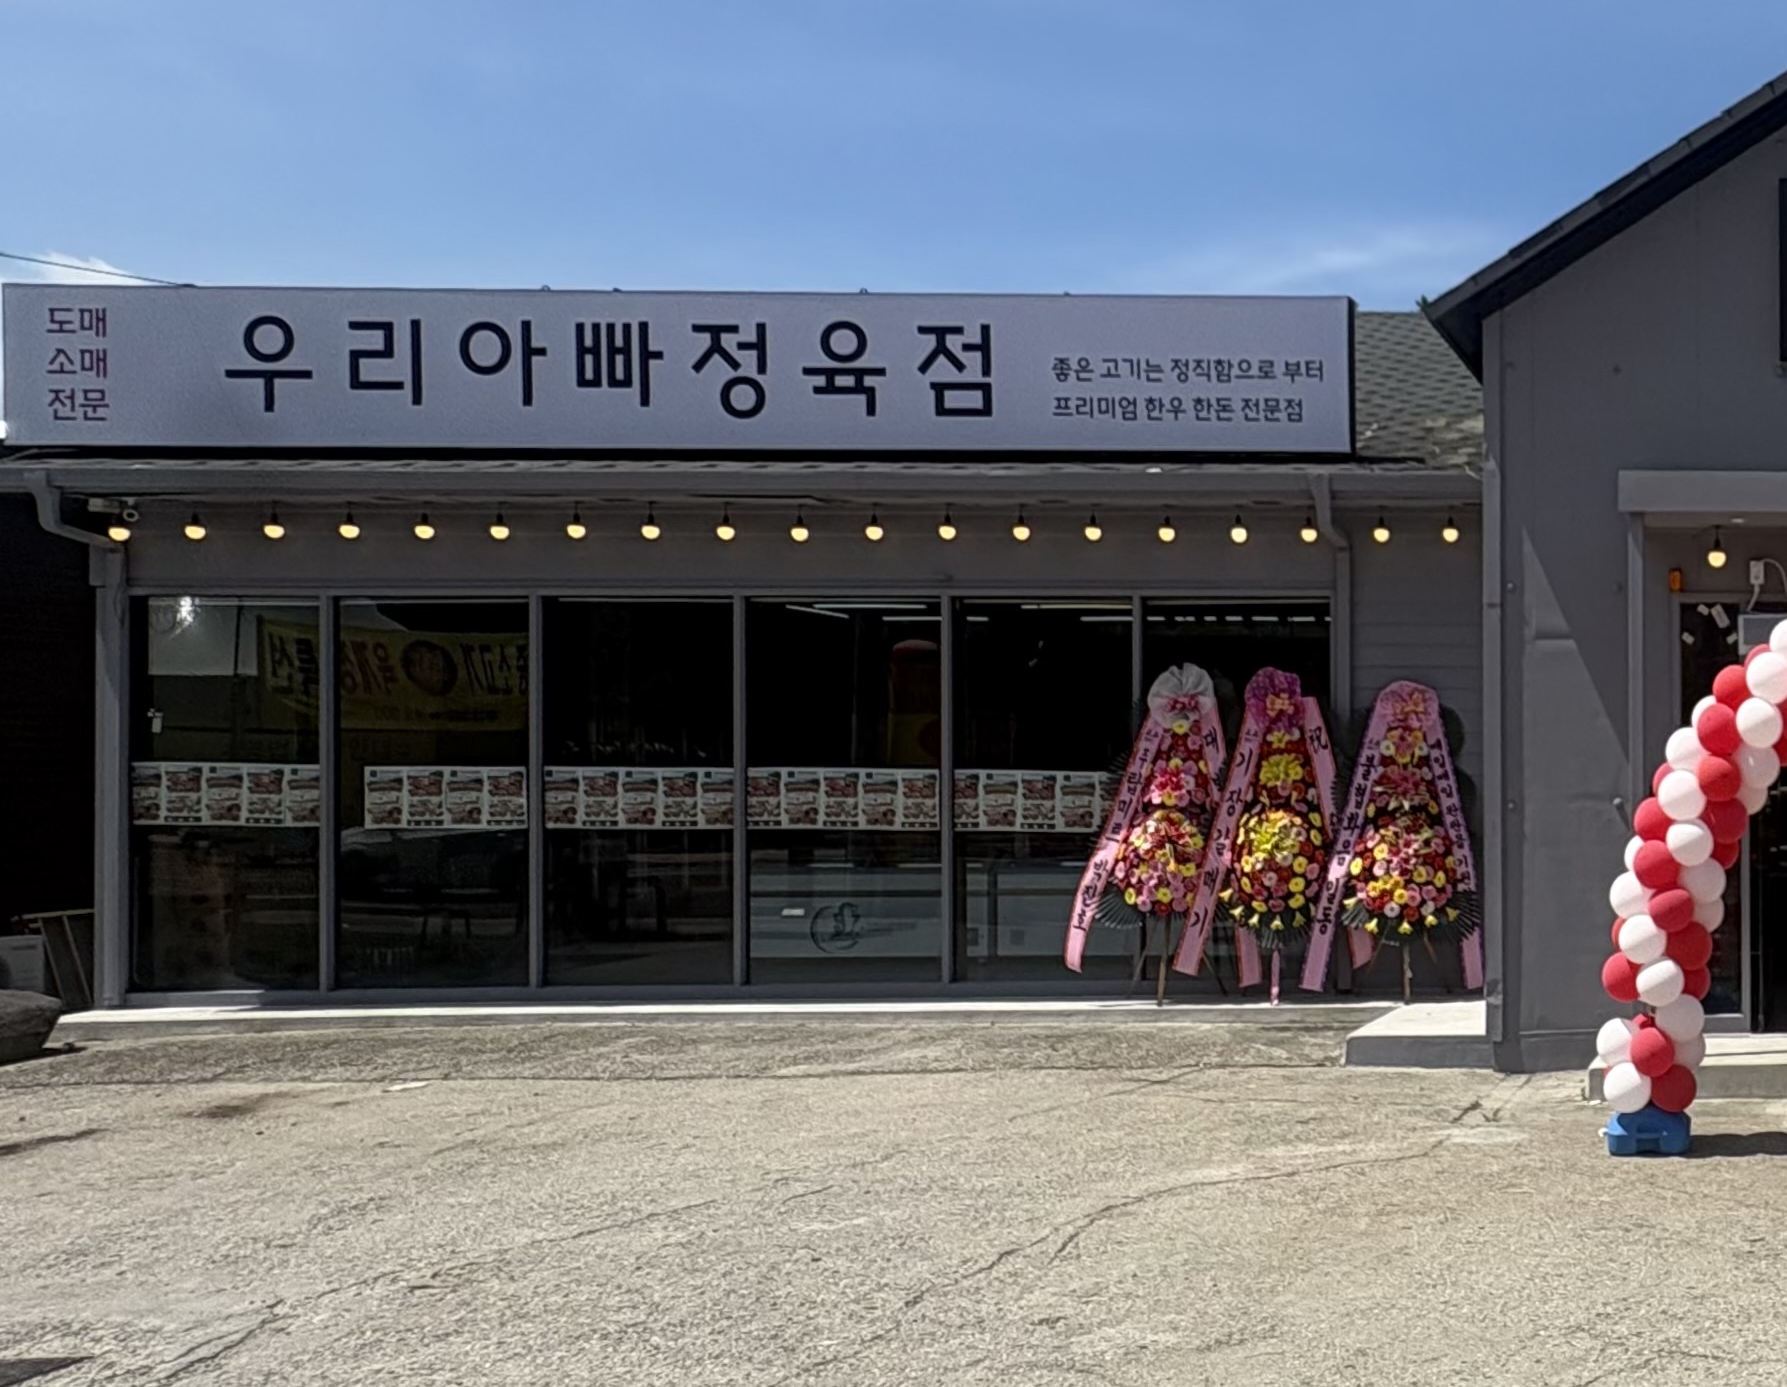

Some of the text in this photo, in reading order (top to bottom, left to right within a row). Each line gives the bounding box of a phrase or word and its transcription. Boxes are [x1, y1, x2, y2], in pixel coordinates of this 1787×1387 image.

[46, 308, 106, 338] 도매
[47, 348, 107, 378] 소매
[225, 316, 992, 419] 우리아빠정육점
[1052, 358, 1323, 383] 좋은 고기는 정직함으로 부터
[48, 388, 109, 421] 전문
[1053, 397, 1303, 422] 프리미엄 한우 한돈 전문점
